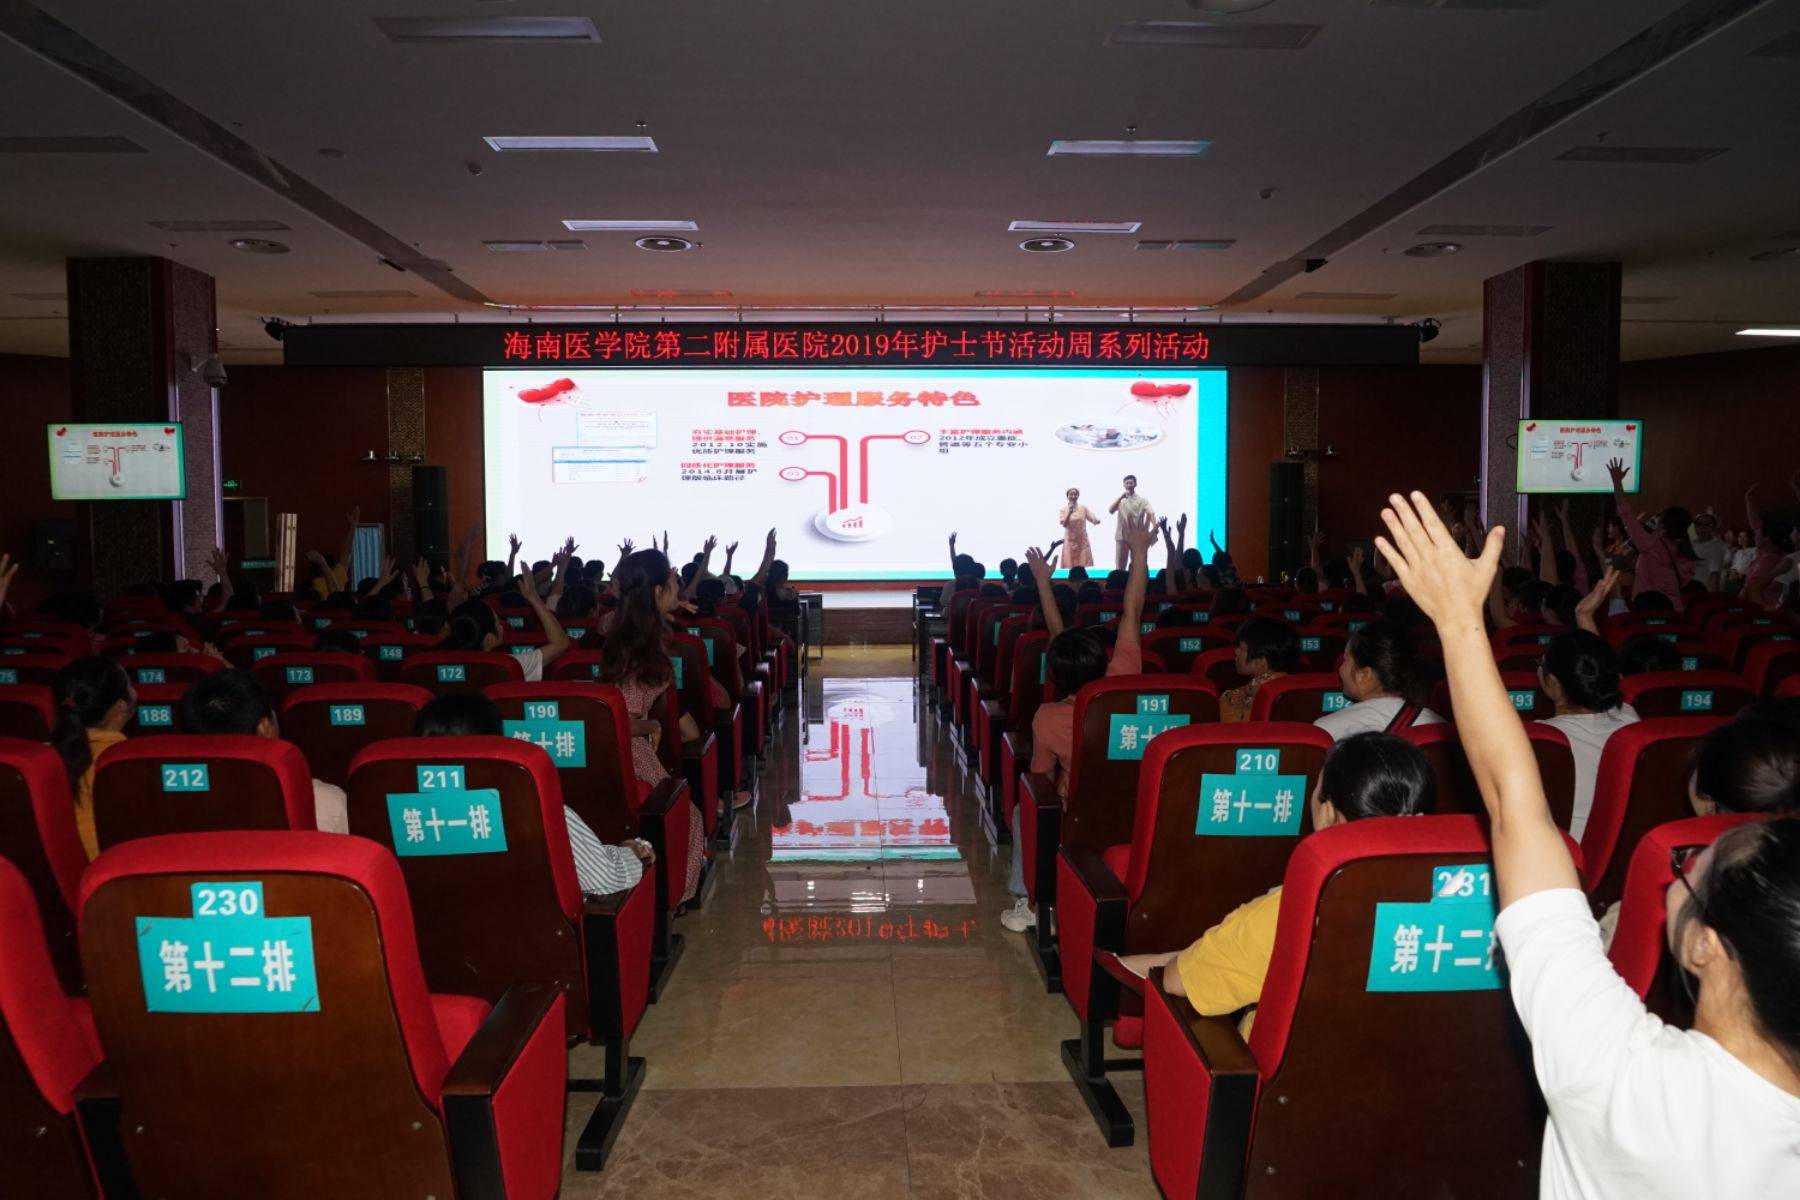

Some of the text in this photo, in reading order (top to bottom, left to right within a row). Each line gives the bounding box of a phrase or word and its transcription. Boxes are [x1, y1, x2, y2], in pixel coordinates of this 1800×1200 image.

[503, 330, 1210, 360] 海南医学院第二附属医院2019年护士节活动周系列活动
[728, 391, 981, 407] 医院护理服务特色
[1182, 640, 1201, 650] 152
[1302, 639, 1321, 649] 153
[383, 648, 403, 658] 148
[140, 670, 164, 683] 174
[289, 670, 312, 682] 173
[440, 668, 465, 680] 172
[1141, 699, 1168, 713] 191
[1686, 693, 1712, 707] 194
[142, 709, 170, 723] 188
[333, 708, 362, 722] 189
[528, 705, 557, 718] 190
[1119, 724, 1178, 752] 第十
[1239, 754, 1278, 772] 210
[164, 769, 205, 788] 212
[422, 771, 461, 788] 211
[1210, 788, 1295, 824] 第十一排
[401, 804, 493, 844] 第十一排
[1437, 871, 1492, 898] 231
[198, 889, 259, 916] 230
[158, 940, 298, 994] 第十二排
